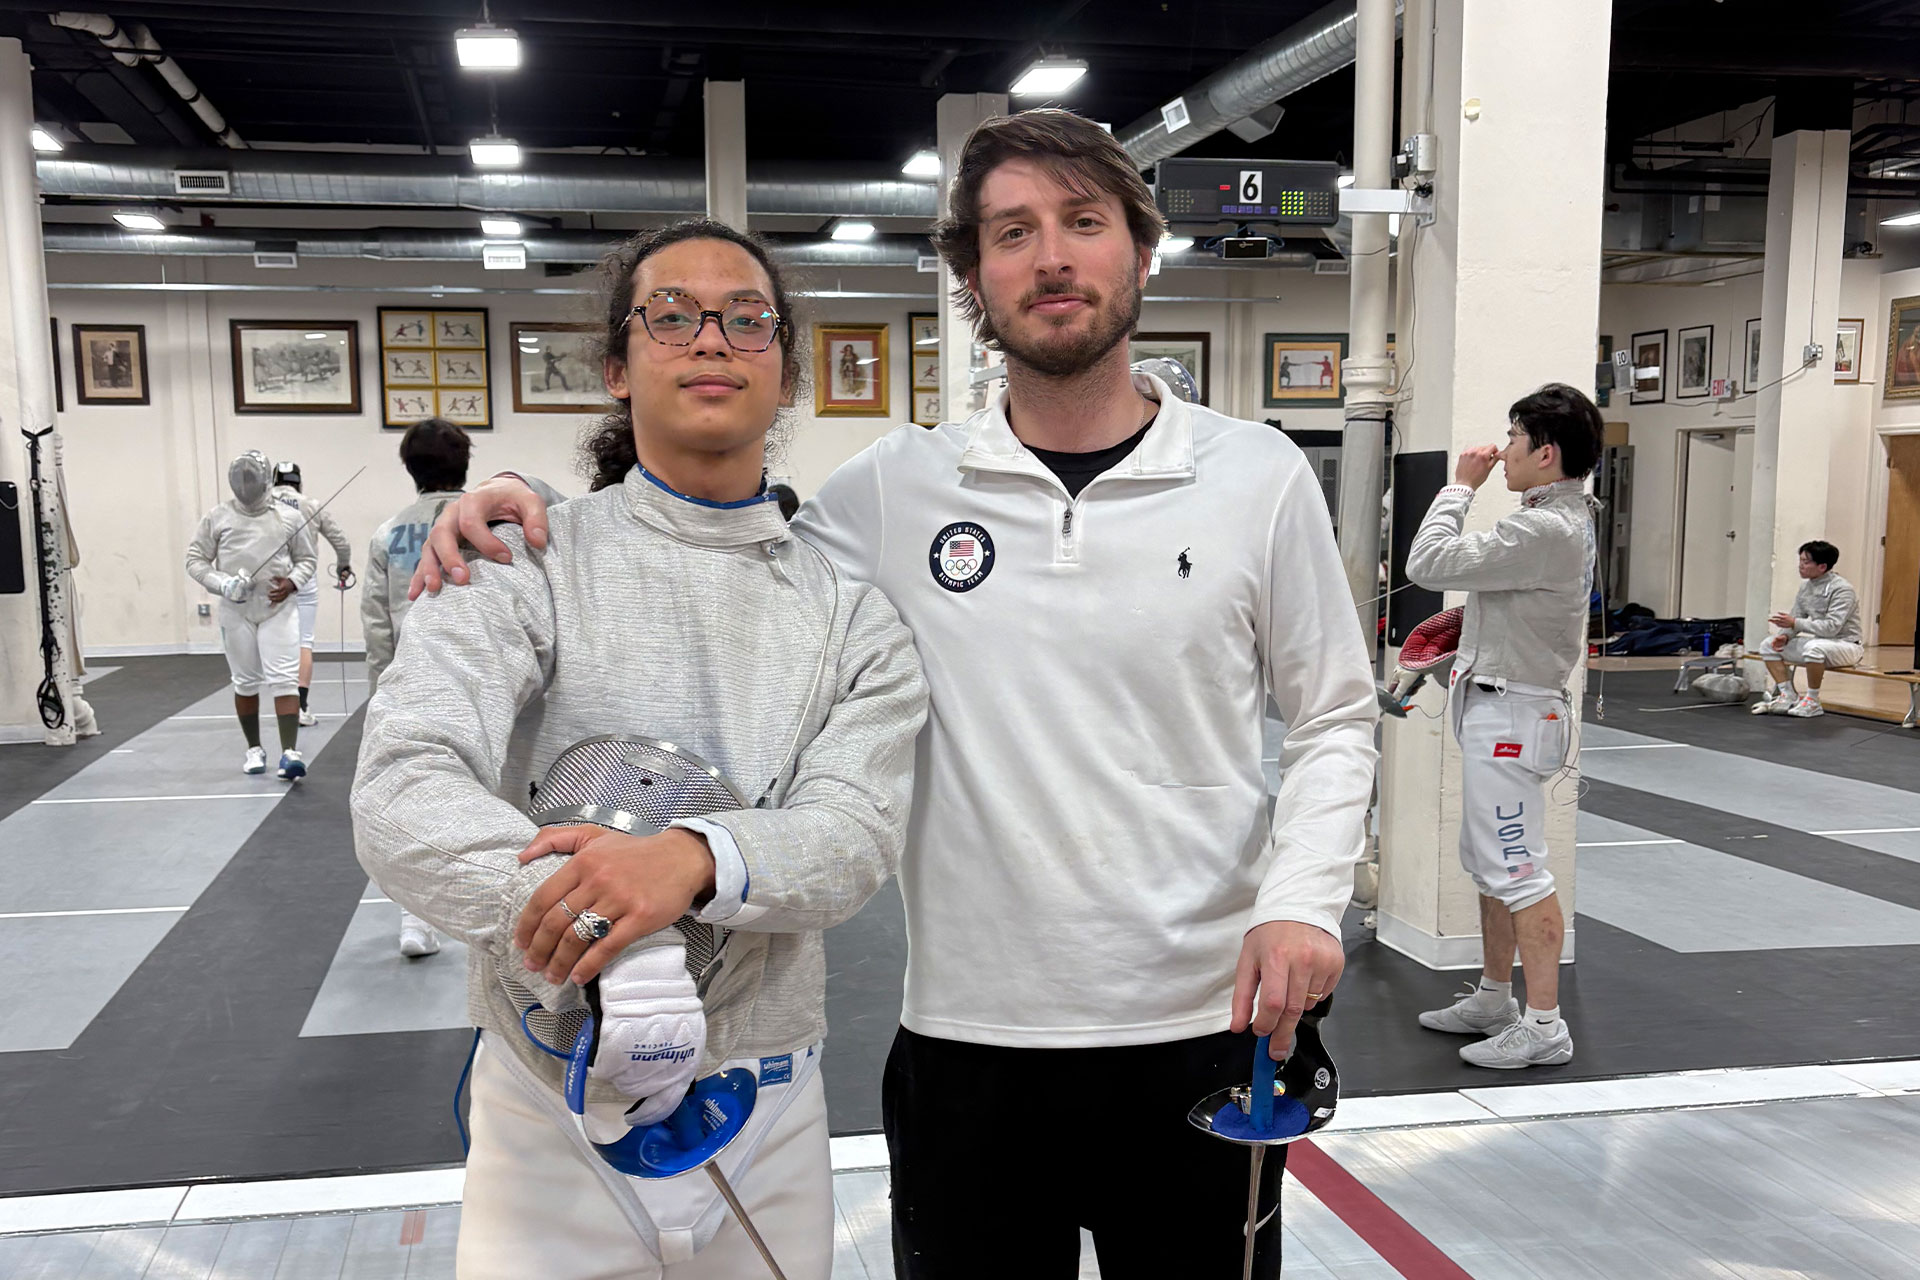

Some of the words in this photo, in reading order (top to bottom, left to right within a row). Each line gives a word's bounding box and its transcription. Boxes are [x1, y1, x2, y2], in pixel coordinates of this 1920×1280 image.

[1242, 173, 1259, 201] 6
[1617, 351, 1626, 365] 10
[939, 526, 962, 545] UNITED
[964, 526, 986, 543] STATES
[938, 571, 964, 588] OLYMPIC
[967, 570, 984, 586] TEAM
[1496, 802, 1531, 861] USA
[631, 1047, 696, 1064] uhlmann
[705, 1097, 729, 1123] uhlmann
